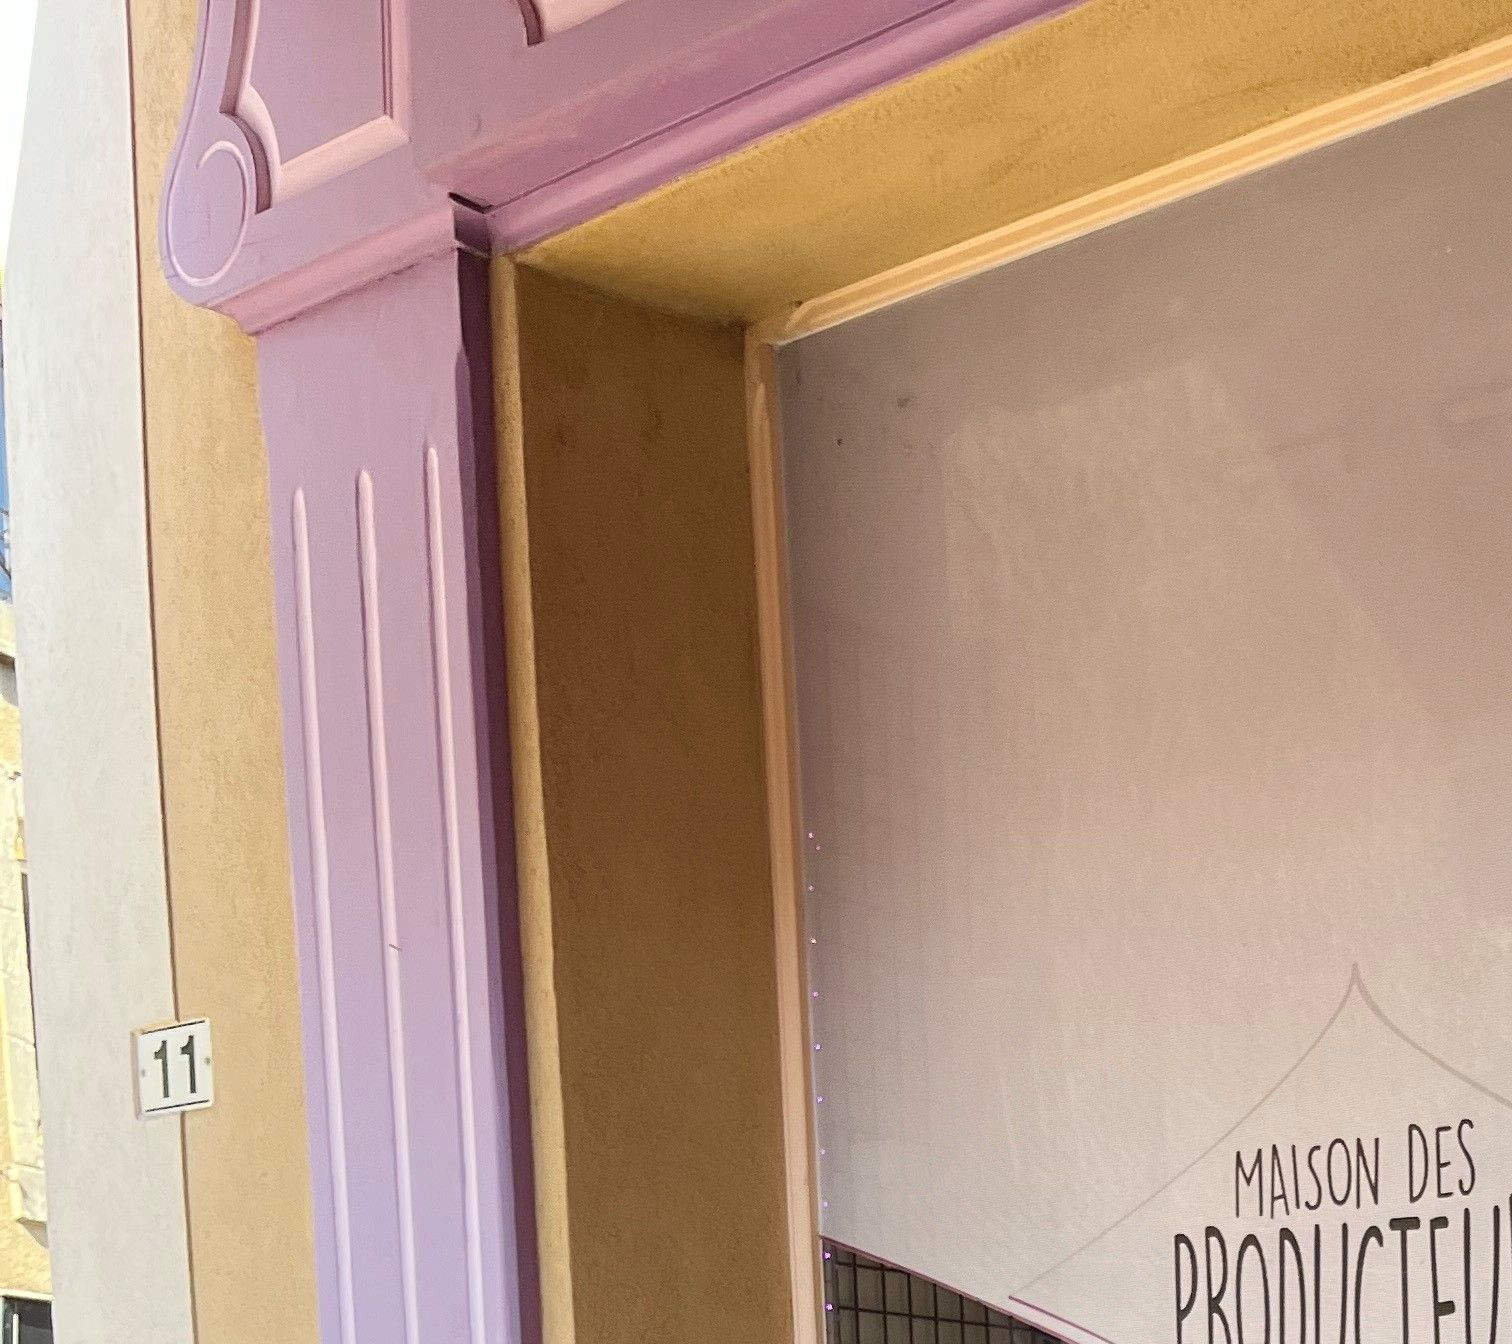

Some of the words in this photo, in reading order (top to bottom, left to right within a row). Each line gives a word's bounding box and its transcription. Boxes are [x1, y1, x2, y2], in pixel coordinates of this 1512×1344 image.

[153, 1034, 197, 1098] 11
[1235, 1137, 1380, 1219] MAISON
[1408, 1118, 1476, 1204] DES
